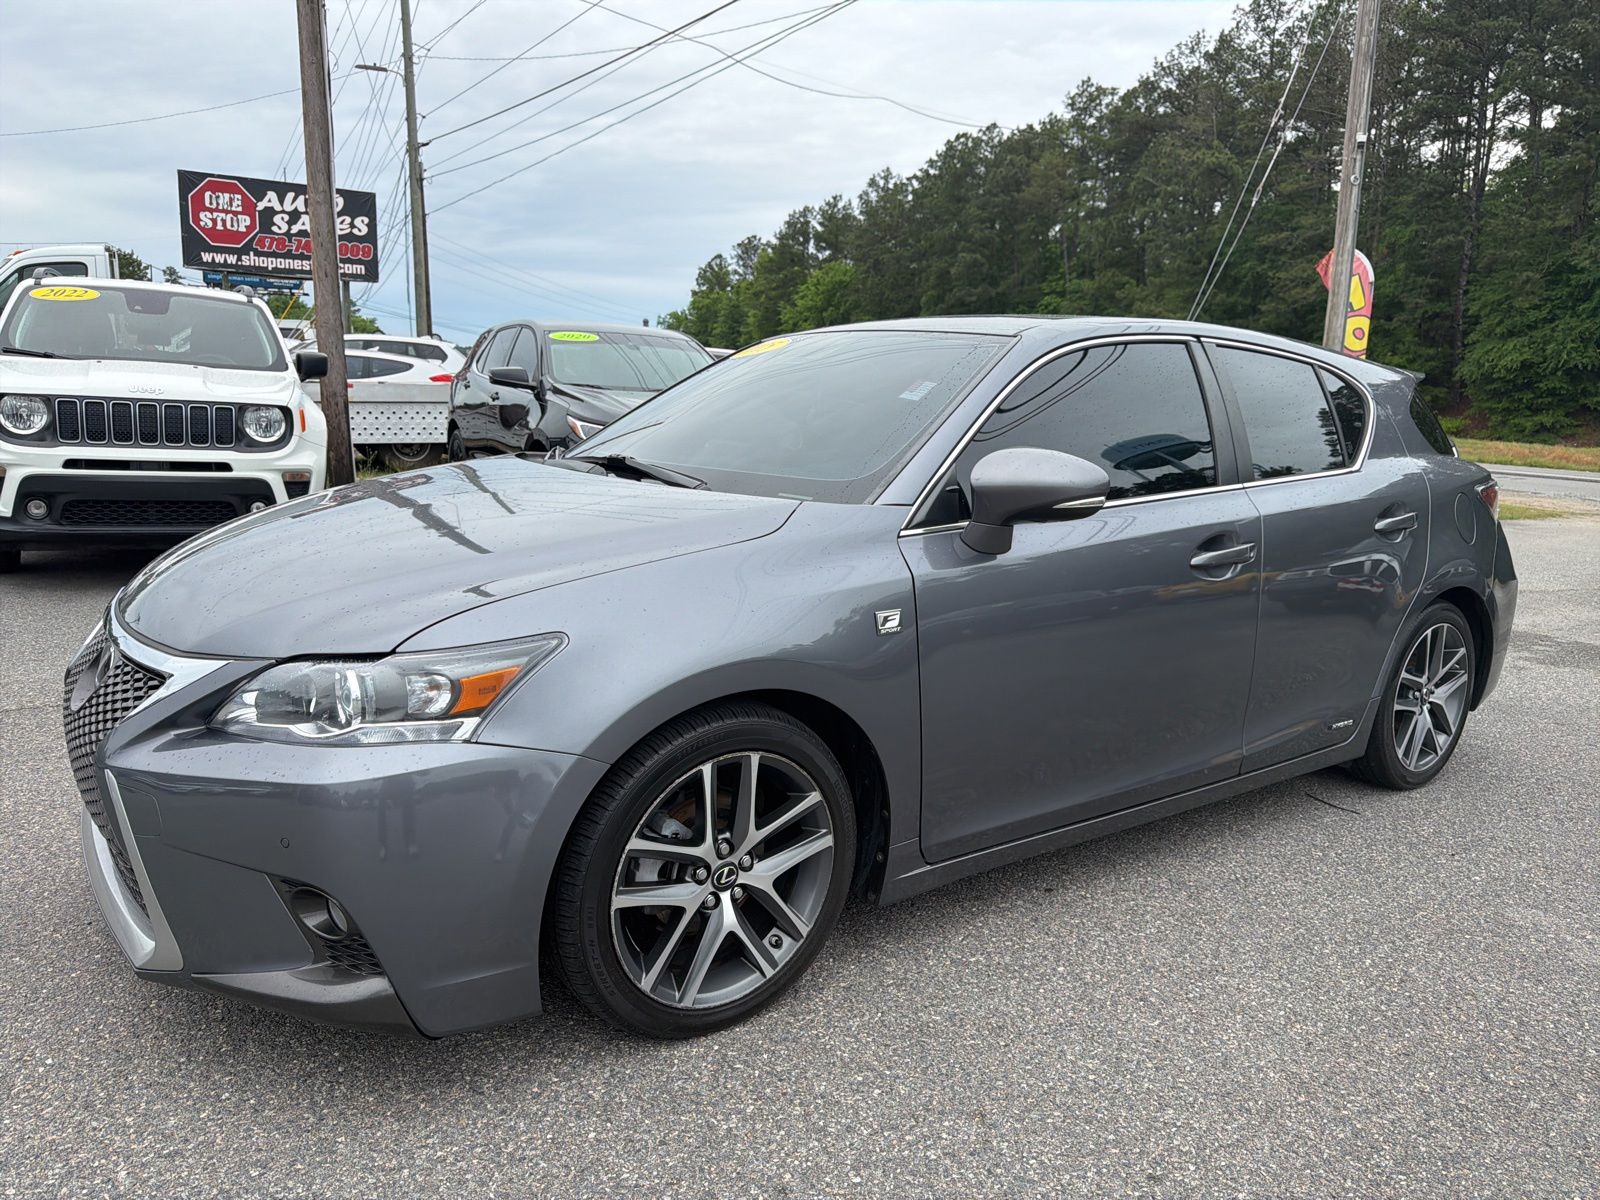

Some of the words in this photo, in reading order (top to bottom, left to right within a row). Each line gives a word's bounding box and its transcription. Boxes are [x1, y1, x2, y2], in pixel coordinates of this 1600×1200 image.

[204, 191, 242, 211] ONE
[256, 191, 344, 213] AU
[199, 211, 251, 232] STOP
[271, 213, 369, 236] SAES
[253, 234, 373, 260] 478-74009
[201, 251, 365, 275] www.shoponescom
[40, 288, 88, 298] 2022
[128, 384, 164, 396] Jeep
